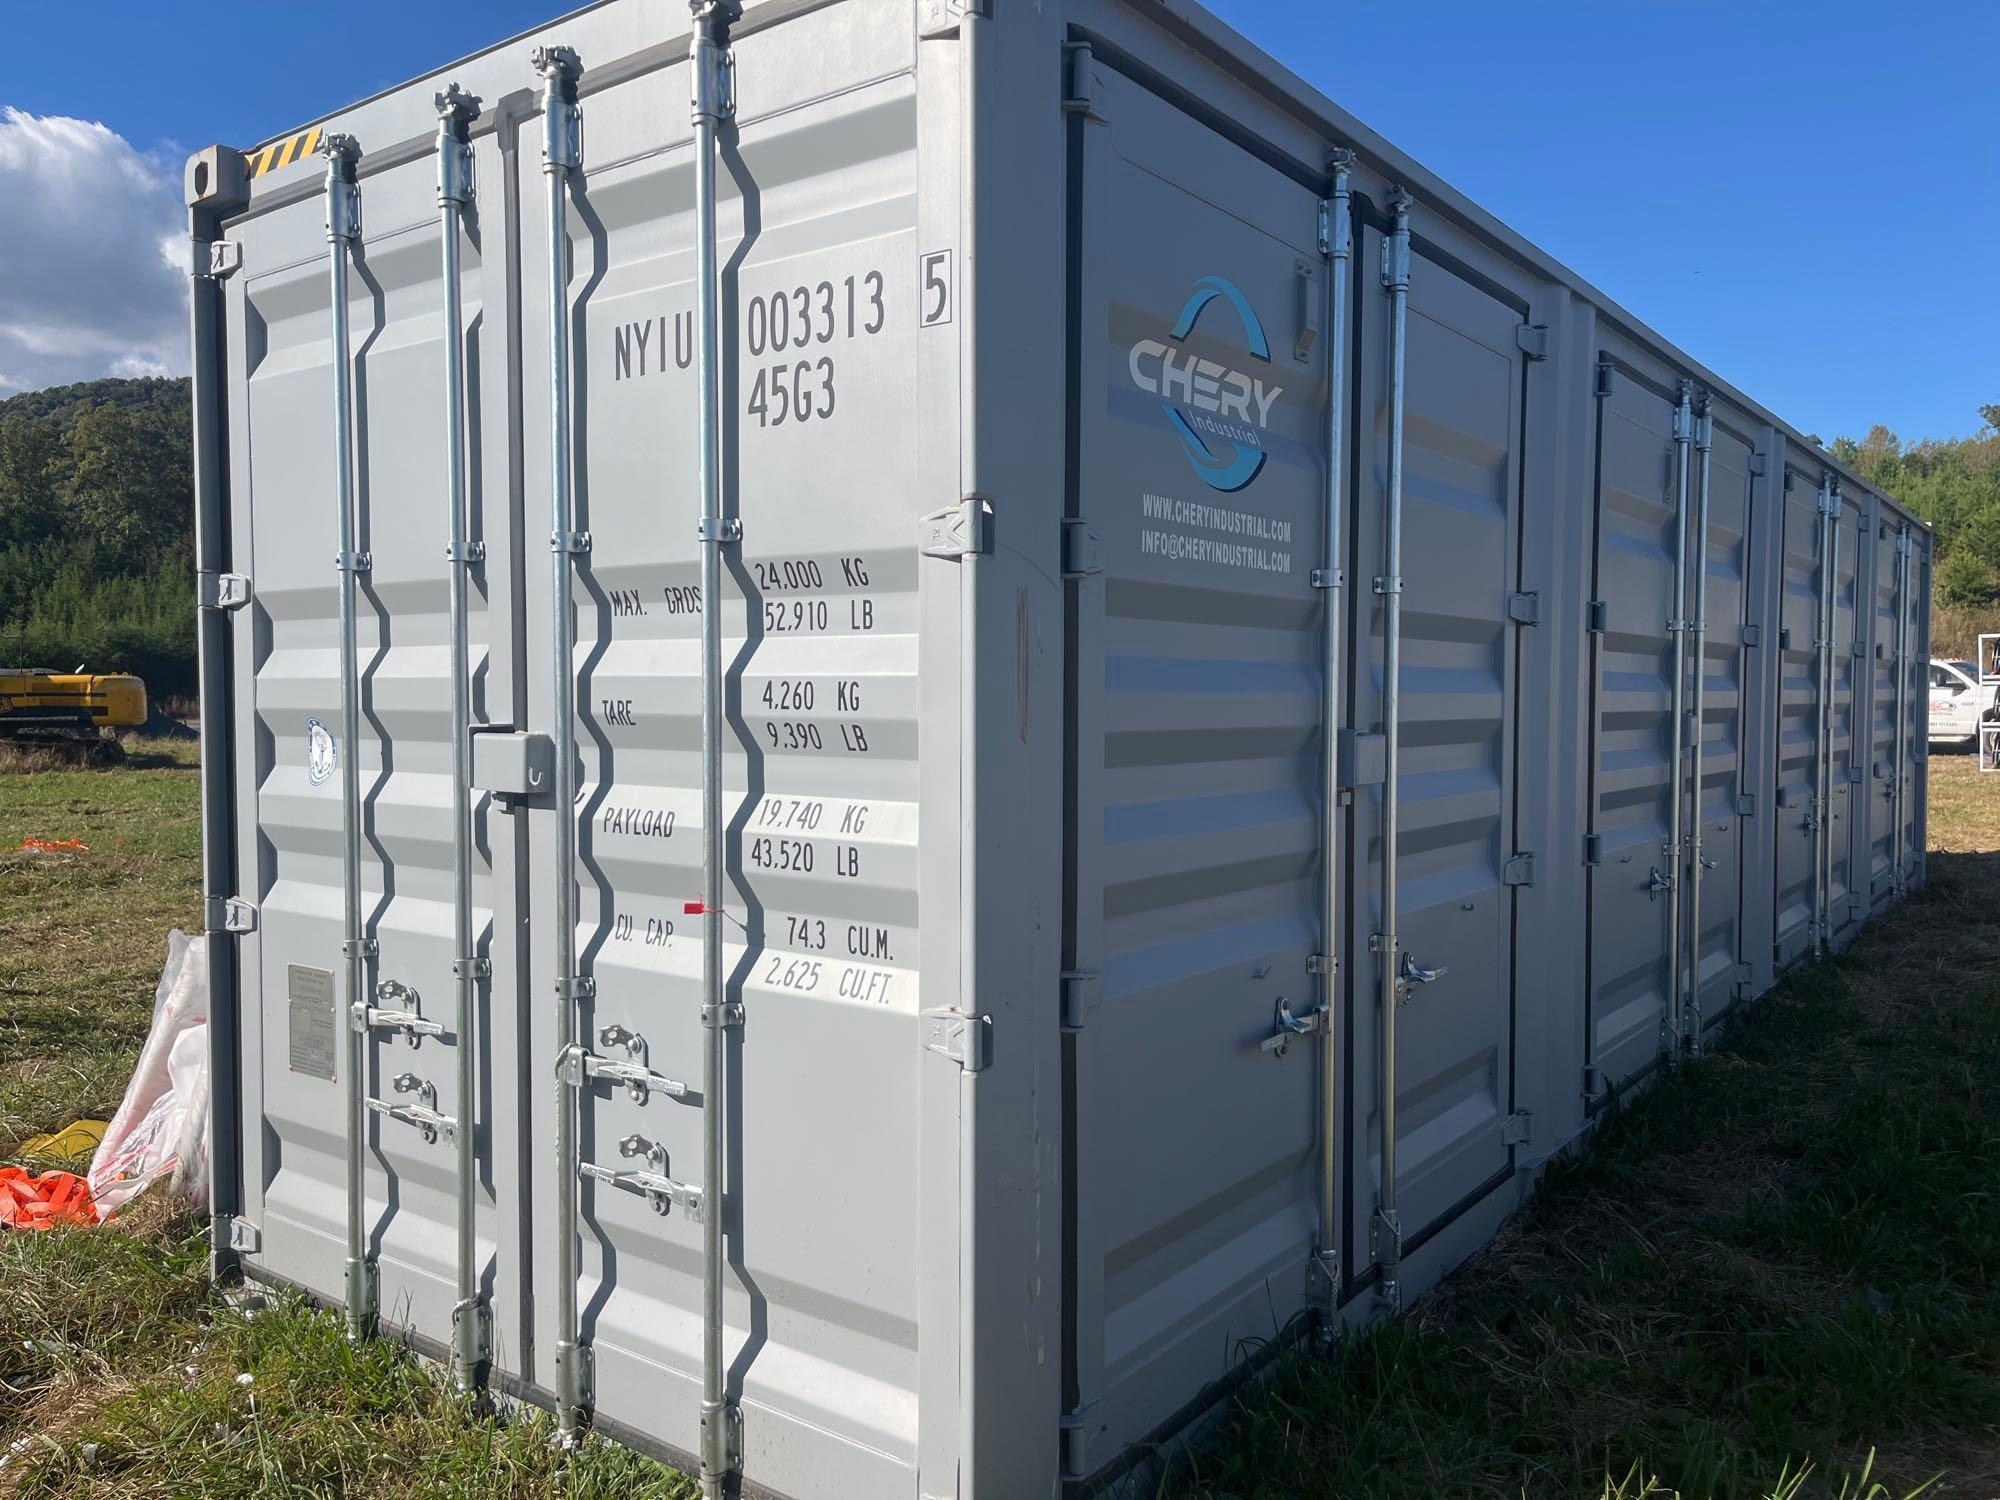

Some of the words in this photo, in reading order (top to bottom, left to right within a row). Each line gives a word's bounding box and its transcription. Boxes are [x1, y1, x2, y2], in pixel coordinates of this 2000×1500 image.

[615, 310, 692, 381] NYIU
[749, 270, 885, 356] 003313
[925, 254, 947, 323] 5
[748, 356, 836, 428] 45G3
[1129, 339, 1283, 428] CHERY
[1190, 411, 1261, 446] Industrial
[1142, 493, 1291, 543] WWW.CHERYINDUSTRIAL.COM
[1141, 529, 1290, 573] INFO@CHERYINDUSTRIAL.COM
[841, 558, 869, 587] KG
[609, 589, 648, 616] MAX.
[664, 586, 702, 614] GROS
[765, 600, 828, 632] 52,910
[851, 599, 874, 631] LB
[602, 699, 637, 726] TARE
[762, 680, 814, 711] 4,260
[837, 680, 860, 711] KG
[841, 724, 868, 751] LB
[603, 806, 676, 838] PAYLOAD
[758, 798, 823, 830] 19,740
[840, 804, 869, 834] KG
[751, 837, 814, 872] 43,520
[837, 846, 859, 877] LB
[615, 913, 632, 941] CU.
[646, 918, 673, 947] CAP.
[787, 916, 826, 950] 74.3
[847, 925, 894, 960] CU.M.
[764, 956, 823, 991] 2,625
[838, 967, 893, 1005] CU.FT.
